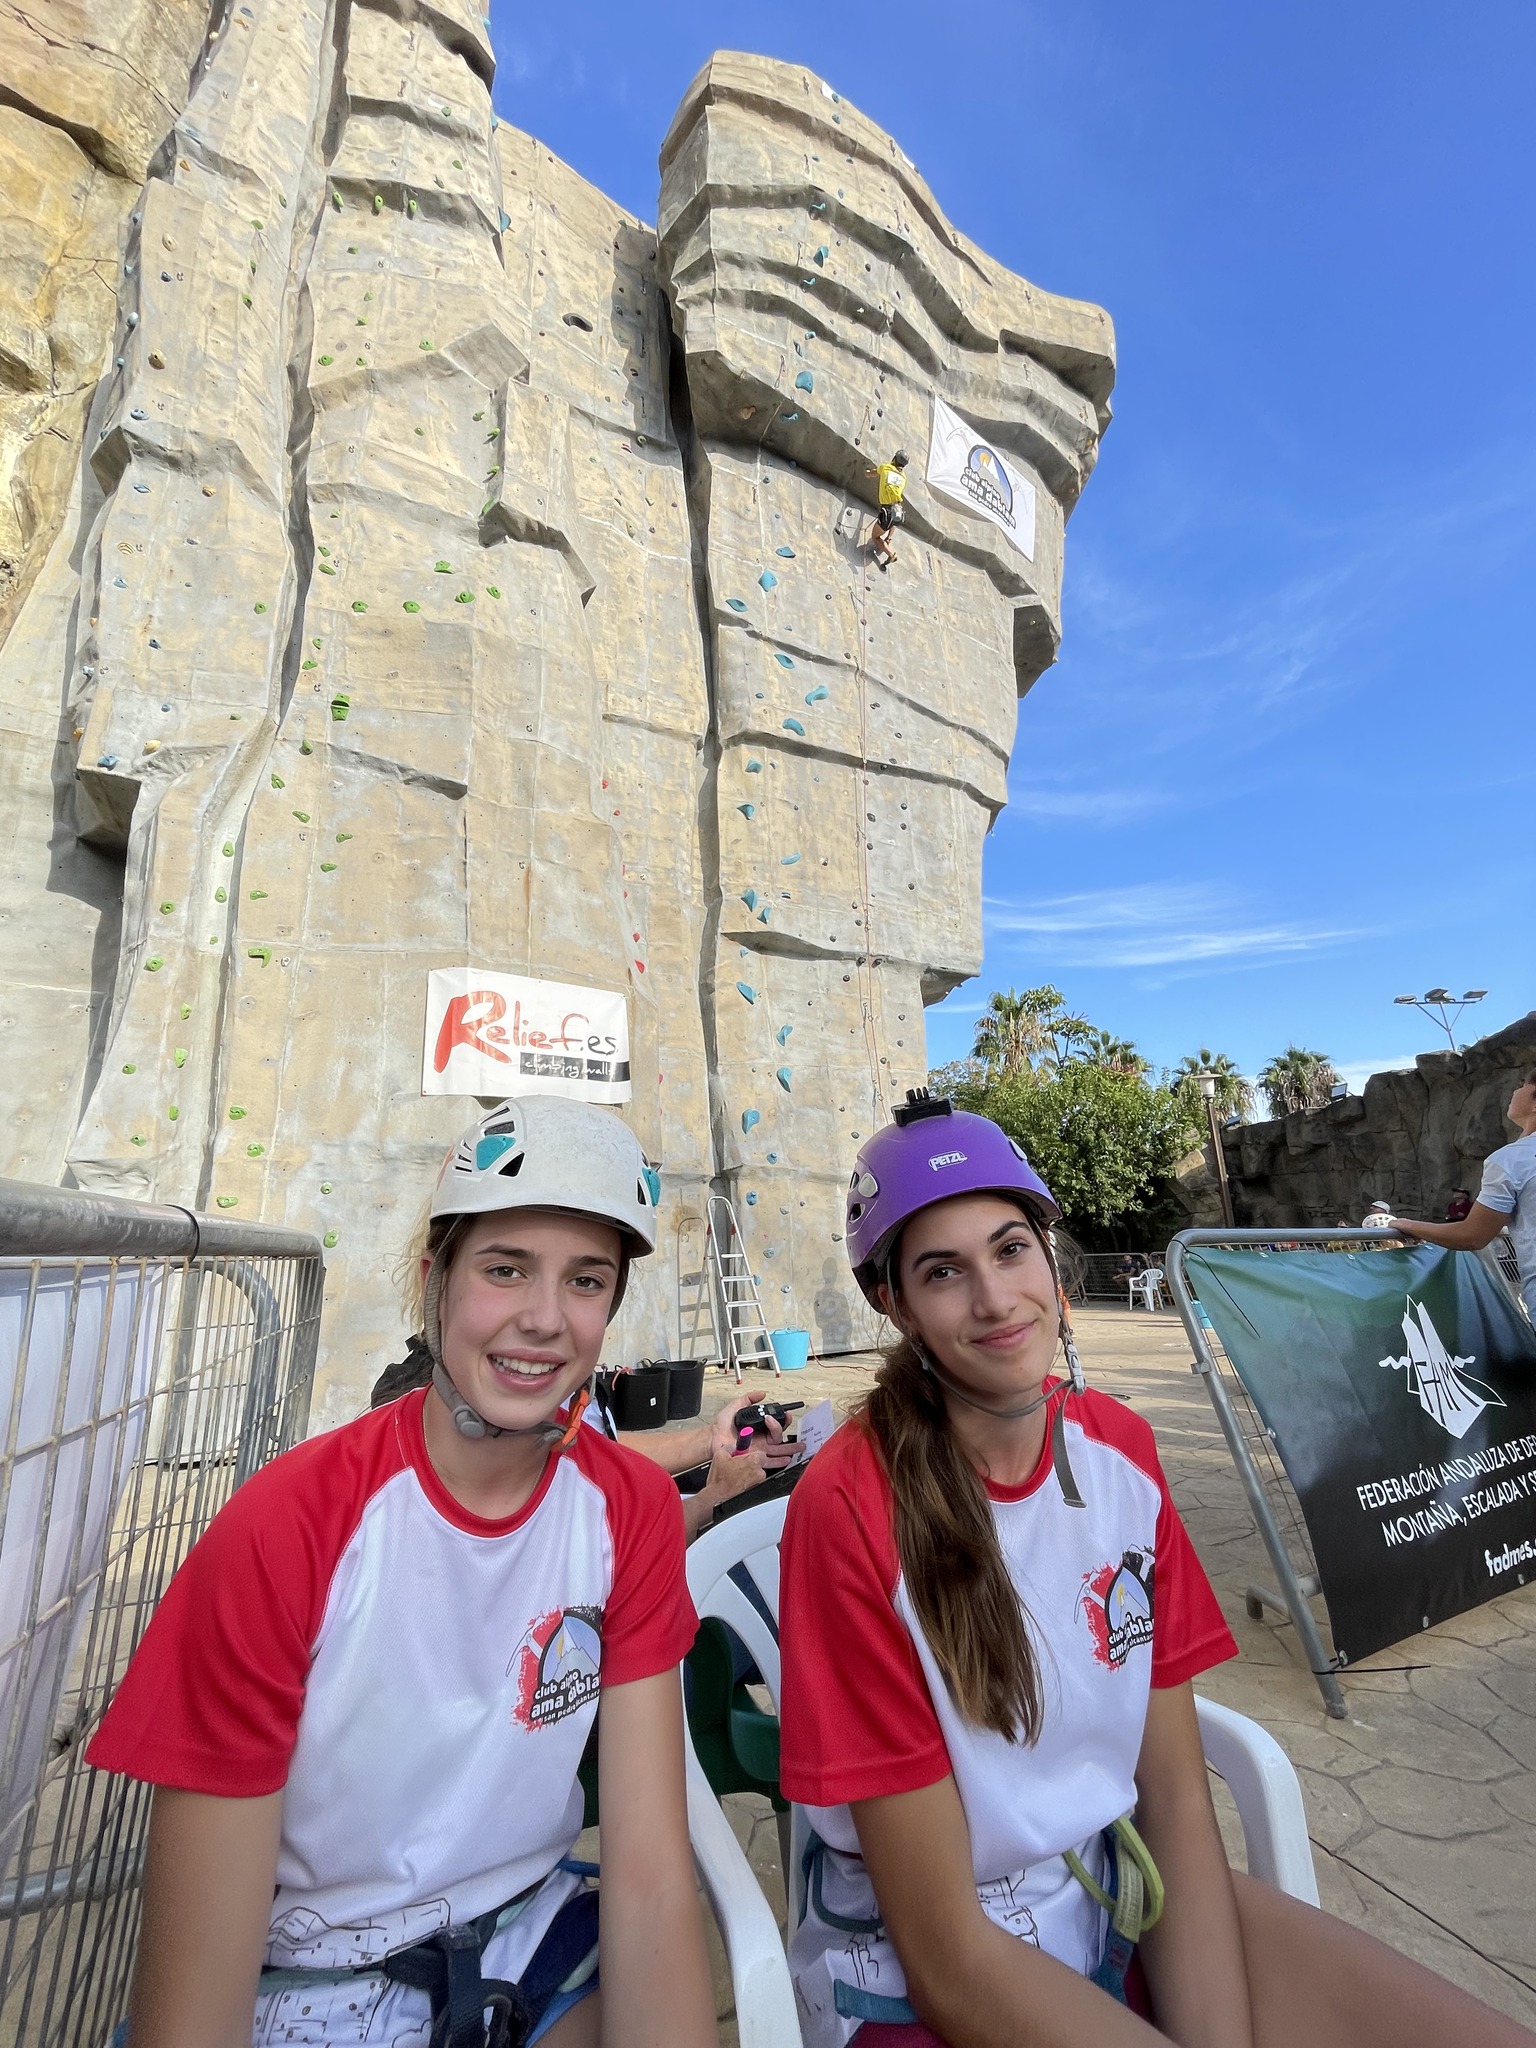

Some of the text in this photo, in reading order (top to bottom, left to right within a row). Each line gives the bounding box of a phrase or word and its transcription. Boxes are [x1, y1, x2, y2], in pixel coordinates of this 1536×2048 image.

[961, 475, 984, 498] ama
[964, 467, 981, 483] club
[525, 1053, 580, 1078] climbing
[930, 1151, 968, 1171] PETZL
[1356, 1462, 1443, 1511] FEDERACIÓN
[1438, 1445, 1511, 1486] ANDALUZA
[1504, 1440, 1525, 1463] DE
[1381, 1500, 1468, 1547] MONTAÑA,
[1461, 1479, 1524, 1519] ESCALADA
[1516, 1474, 1531, 1496] Y
[1484, 1538, 1536, 1577] fadmes.
[1108, 1629, 1124, 1645] club
[535, 1682, 558, 1700] club
[531, 1695, 564, 1718] ama
[544, 1713, 556, 1722] san
